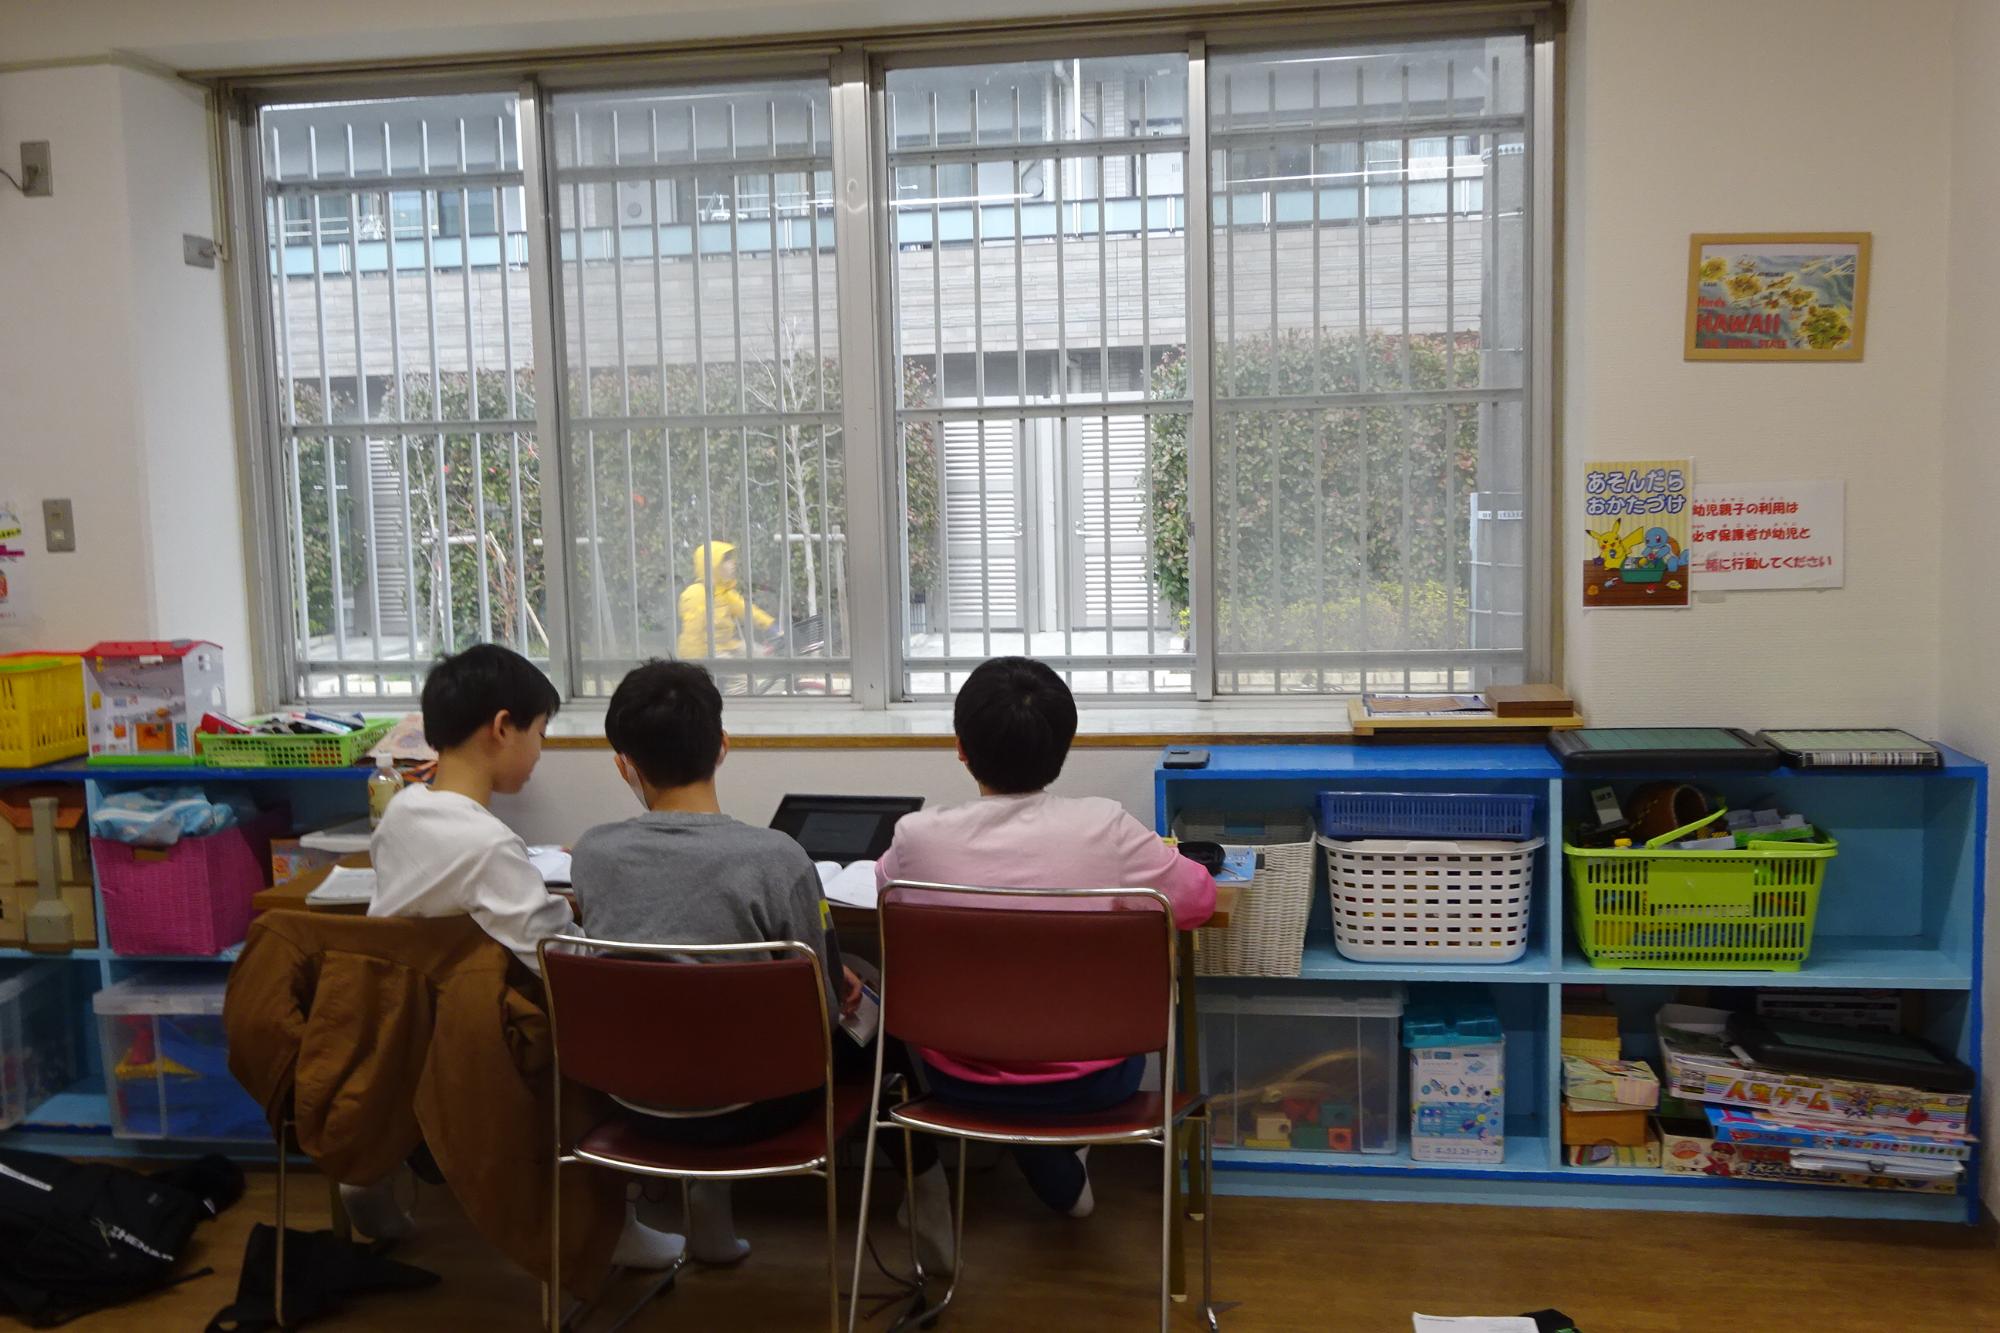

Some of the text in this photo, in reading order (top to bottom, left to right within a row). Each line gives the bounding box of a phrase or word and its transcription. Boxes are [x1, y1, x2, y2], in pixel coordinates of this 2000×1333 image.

[1697, 313, 1780, 334] HAWAII
[1586, 470, 1685, 494] あそんだら
[1586, 495, 1686, 516] おかたづけ
[1692, 502, 1799, 518] 幼児親子の利用は
[1692, 527, 1810, 542] 必ず保護者が幼児と
[1724, 1079, 1831, 1112] 人生ゲーム
